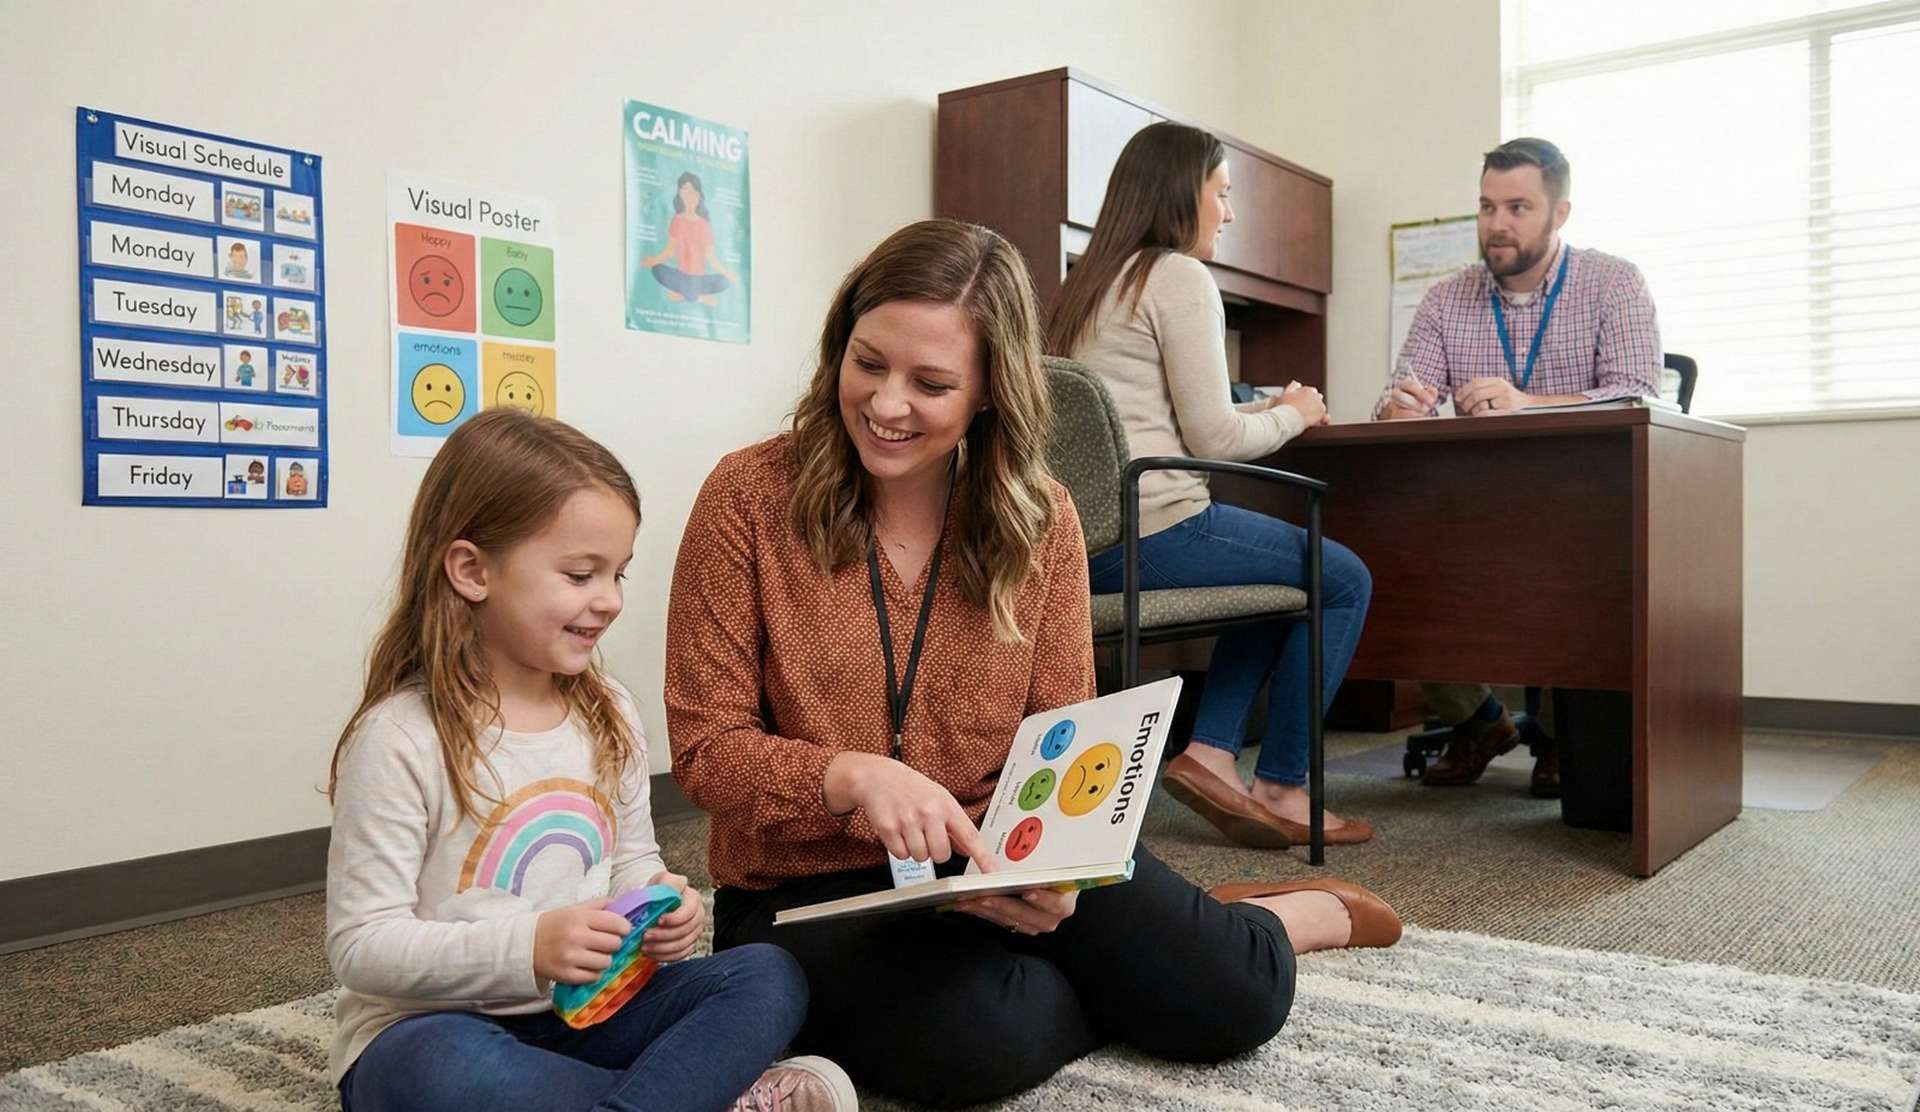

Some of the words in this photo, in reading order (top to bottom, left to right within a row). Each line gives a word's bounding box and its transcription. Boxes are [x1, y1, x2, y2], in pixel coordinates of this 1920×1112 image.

[633, 111, 742, 161] CALMING
[122, 130, 187, 160] Visual
[193, 144, 284, 178] Schedule
[112, 175, 195, 212] Monday
[408, 187, 471, 220] Visual
[480, 201, 540, 232] Poster
[112, 234, 195, 267] Monday
[112, 291, 198, 323] Tuesday
[97, 348, 216, 381] Wednesday
[413, 342, 462, 356] emotions
[112, 407, 206, 435] Thursday
[130, 465, 193, 486] Friday
[1110, 711, 1160, 825] Emotions
